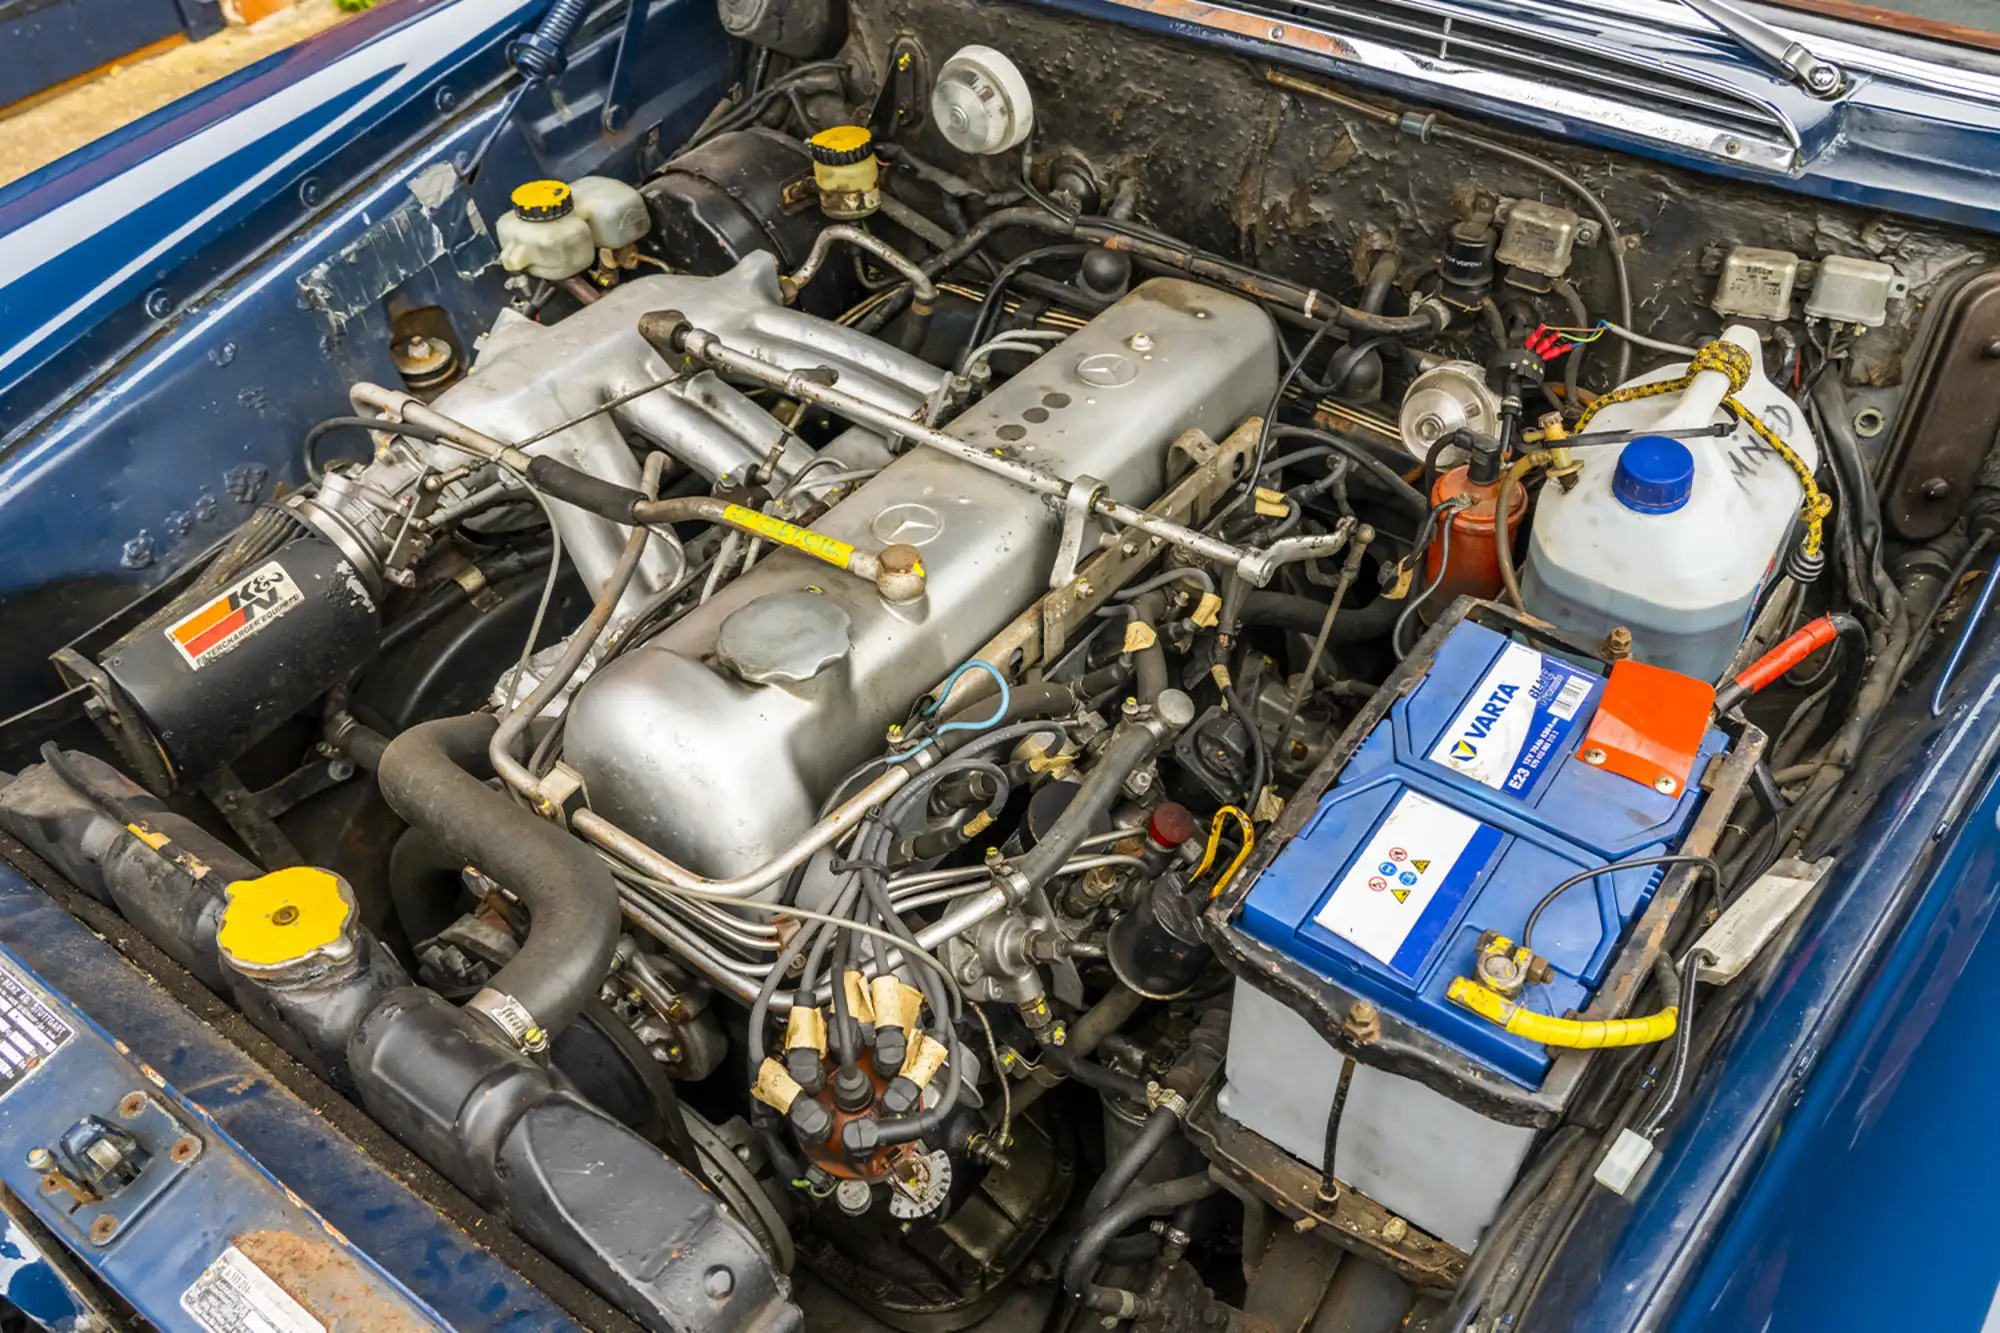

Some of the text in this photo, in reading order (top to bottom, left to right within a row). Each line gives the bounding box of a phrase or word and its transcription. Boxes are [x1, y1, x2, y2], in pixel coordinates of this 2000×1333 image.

[228, 571, 284, 623] K&N
[1528, 667, 1554, 700] BLUE
[1464, 682, 1520, 739] VARTA
[1508, 767, 1531, 790] E23
[31, 1002, 66, 1035] STUTTGART
